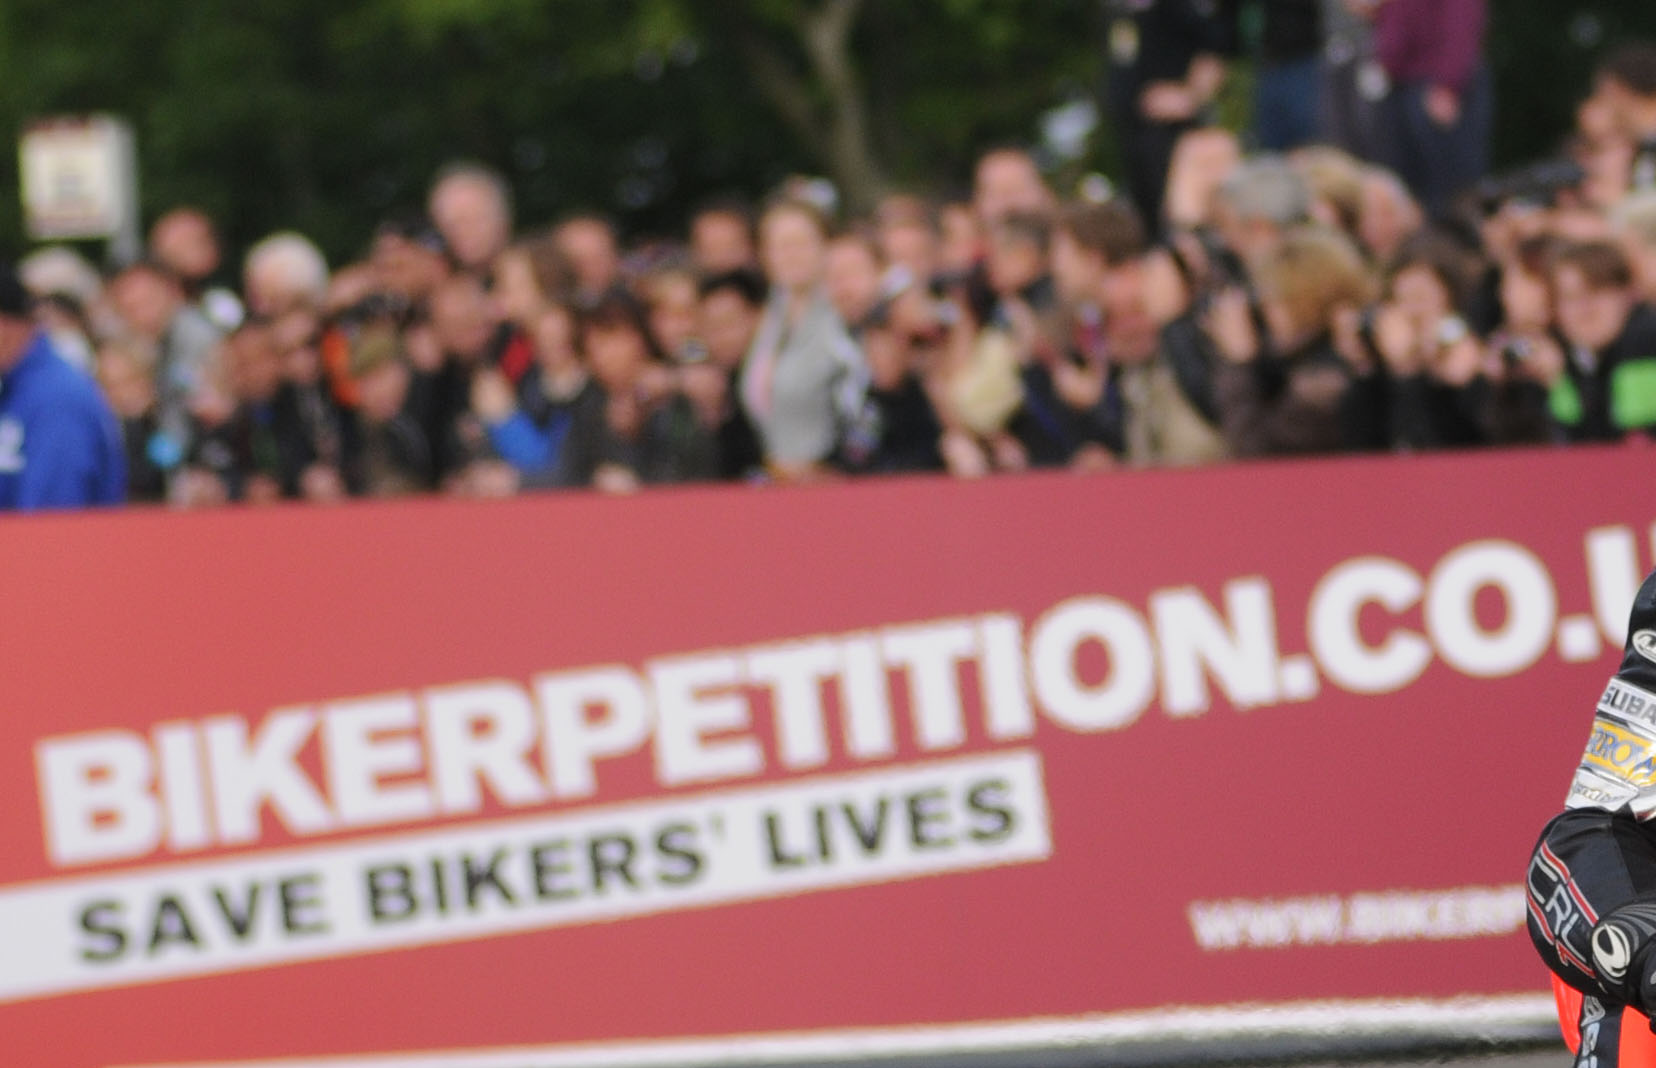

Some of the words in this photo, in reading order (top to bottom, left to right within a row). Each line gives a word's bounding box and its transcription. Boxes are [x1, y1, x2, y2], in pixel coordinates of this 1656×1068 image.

[76, 870, 330, 967] SAVE
[364, 815, 728, 925] BIKERS'
[763, 776, 1014, 871] LIVES
[1529, 855, 1587, 963] CRL
